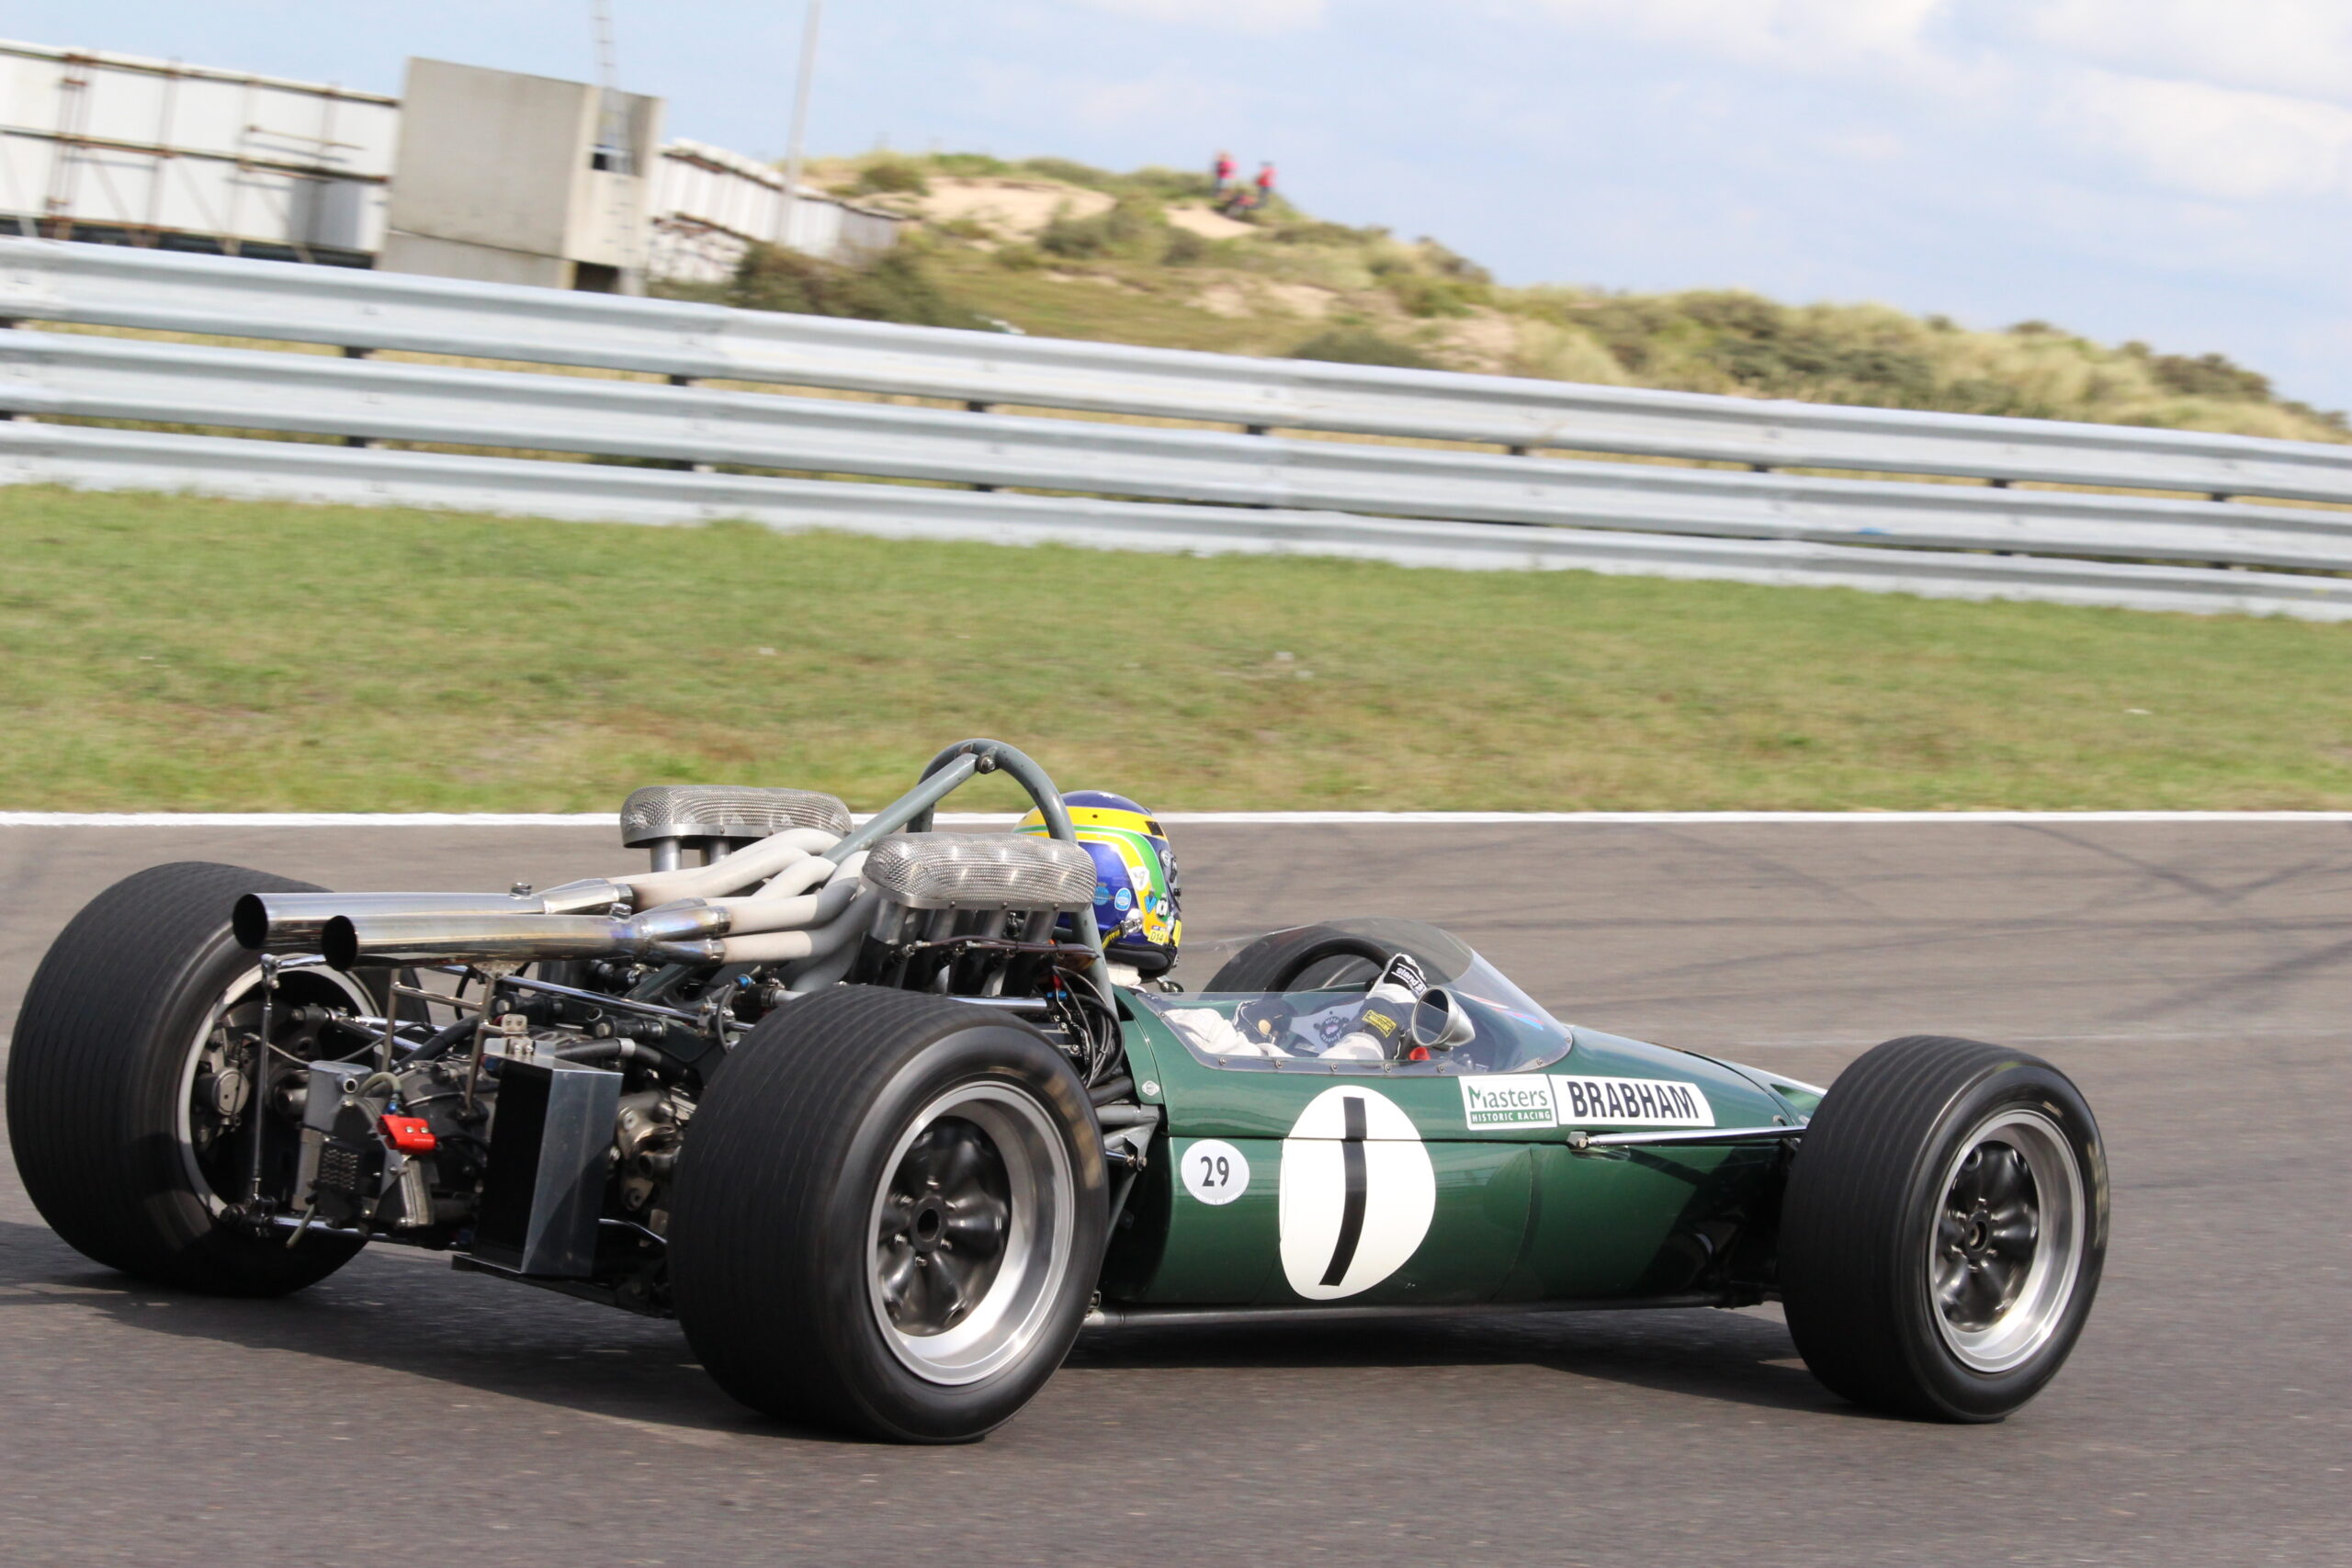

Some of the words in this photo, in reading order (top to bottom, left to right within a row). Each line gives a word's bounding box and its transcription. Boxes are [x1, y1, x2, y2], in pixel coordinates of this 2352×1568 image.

[1467, 1085, 1548, 1109] Masters
[1566, 1080, 1700, 1119] BRABHAM
[1472, 1112, 1514, 1122] HISTORIC
[1517, 1111, 1551, 1121] RACING
[1200, 1156, 1229, 1187] 29
[1317, 1096, 1368, 1287] 1
